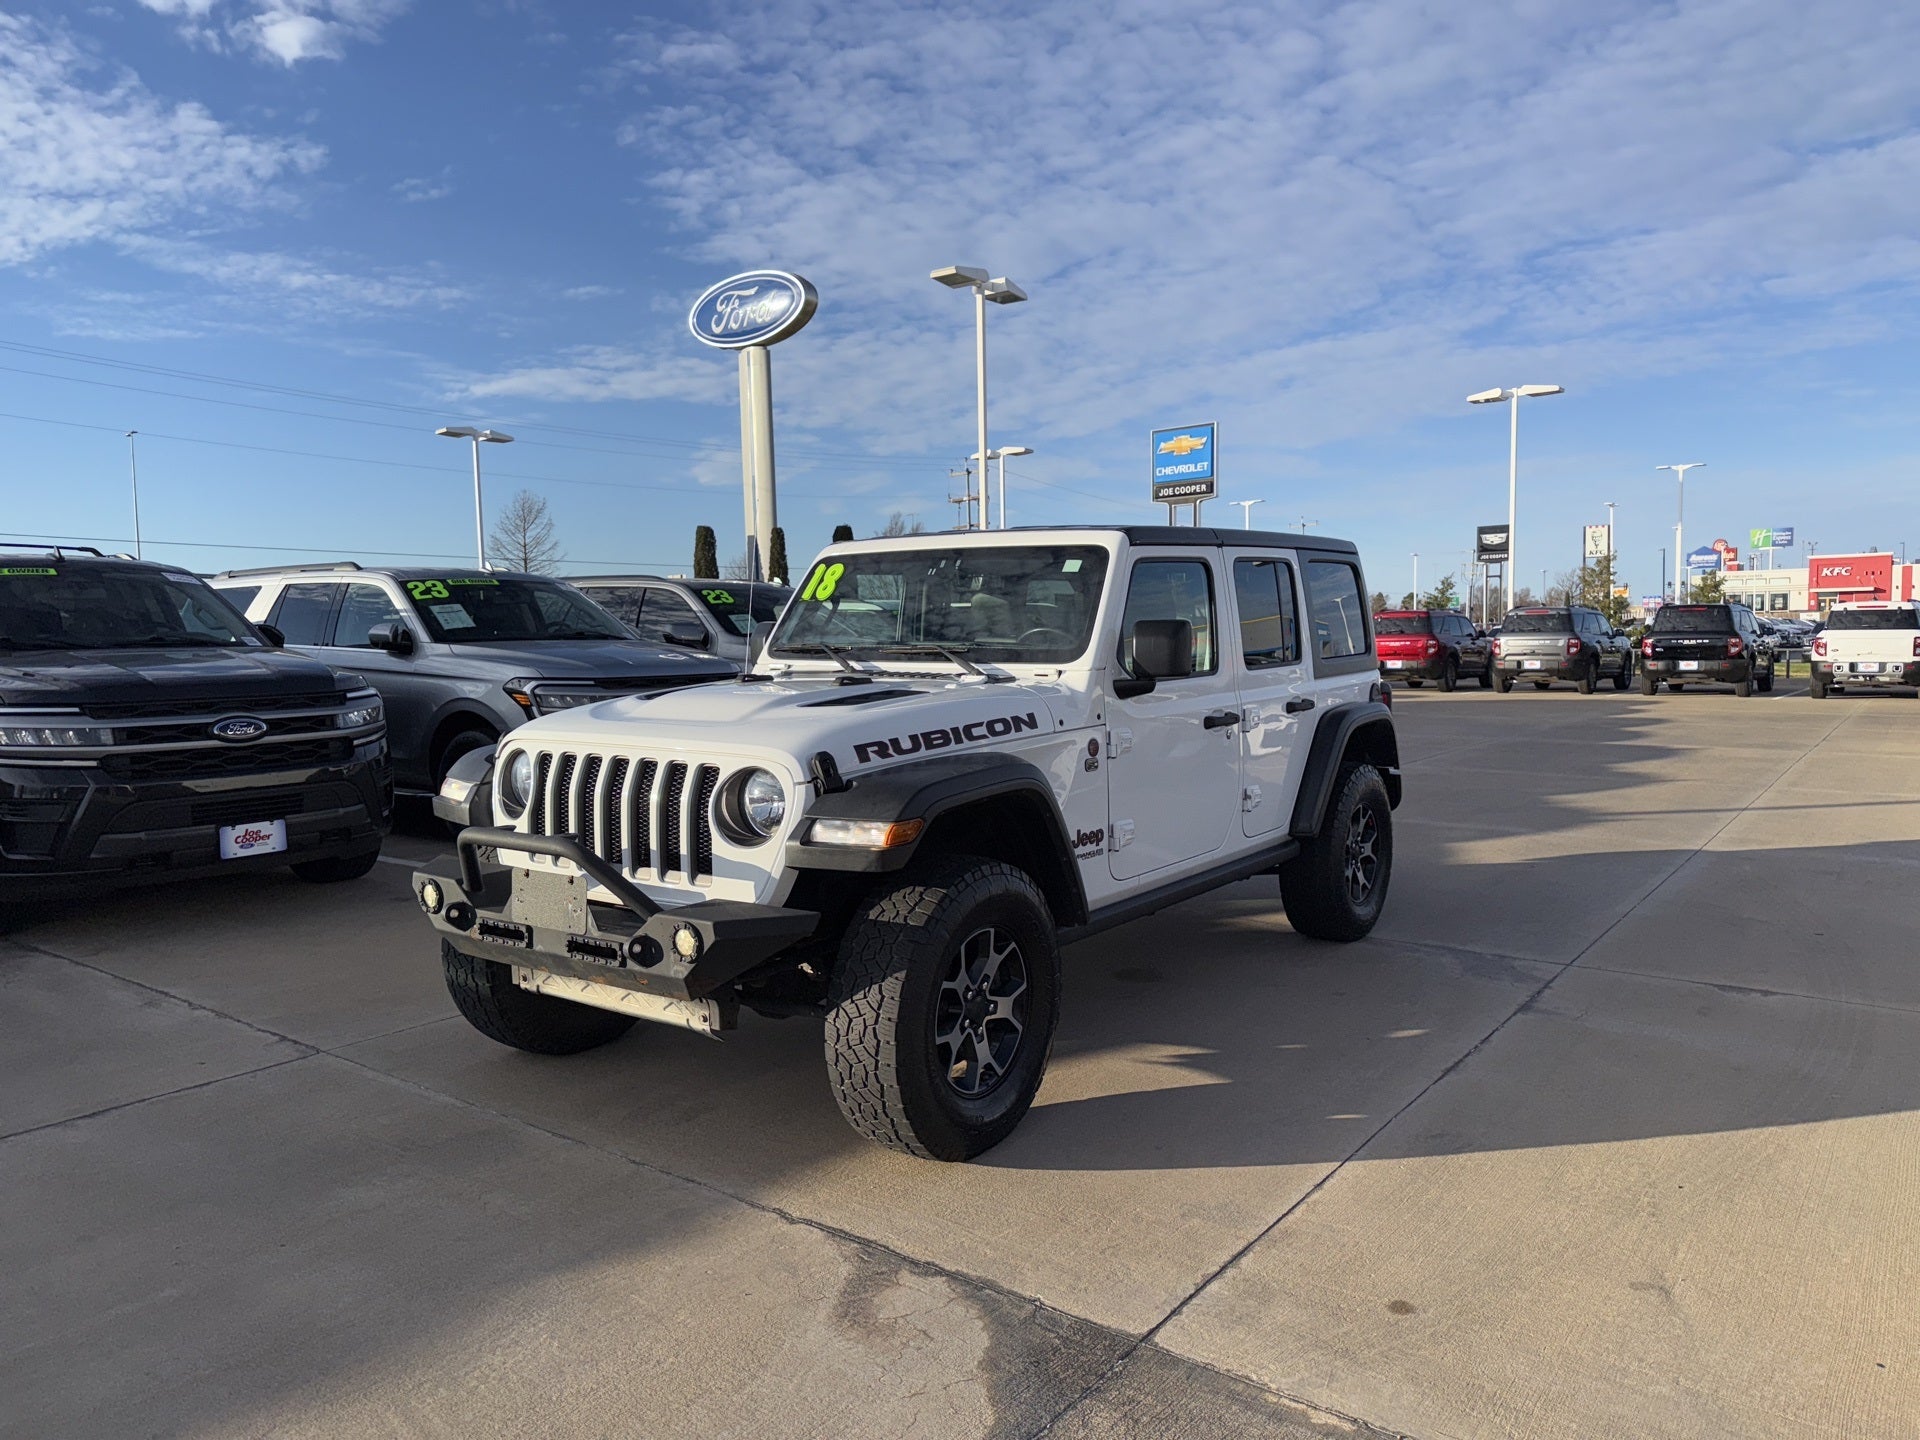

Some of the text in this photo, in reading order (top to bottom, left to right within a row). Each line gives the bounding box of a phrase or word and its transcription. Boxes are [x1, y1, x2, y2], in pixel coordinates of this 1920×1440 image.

[711, 286, 777, 334] Ford
[1156, 461, 1209, 477] CHEVROLET
[1158, 484, 1207, 497] JOE COOPER
[1821, 566, 1852, 577] KFC
[801, 562, 845, 601] 18
[406, 580, 450, 600] 23
[701, 589, 735, 604] 23
[227, 722, 256, 735] Ford
[853, 712, 1039, 764] RUBICON
[234, 833, 273, 845] Cooper
[242, 828, 262, 838] Joe
[1071, 828, 1105, 849] Jeep
